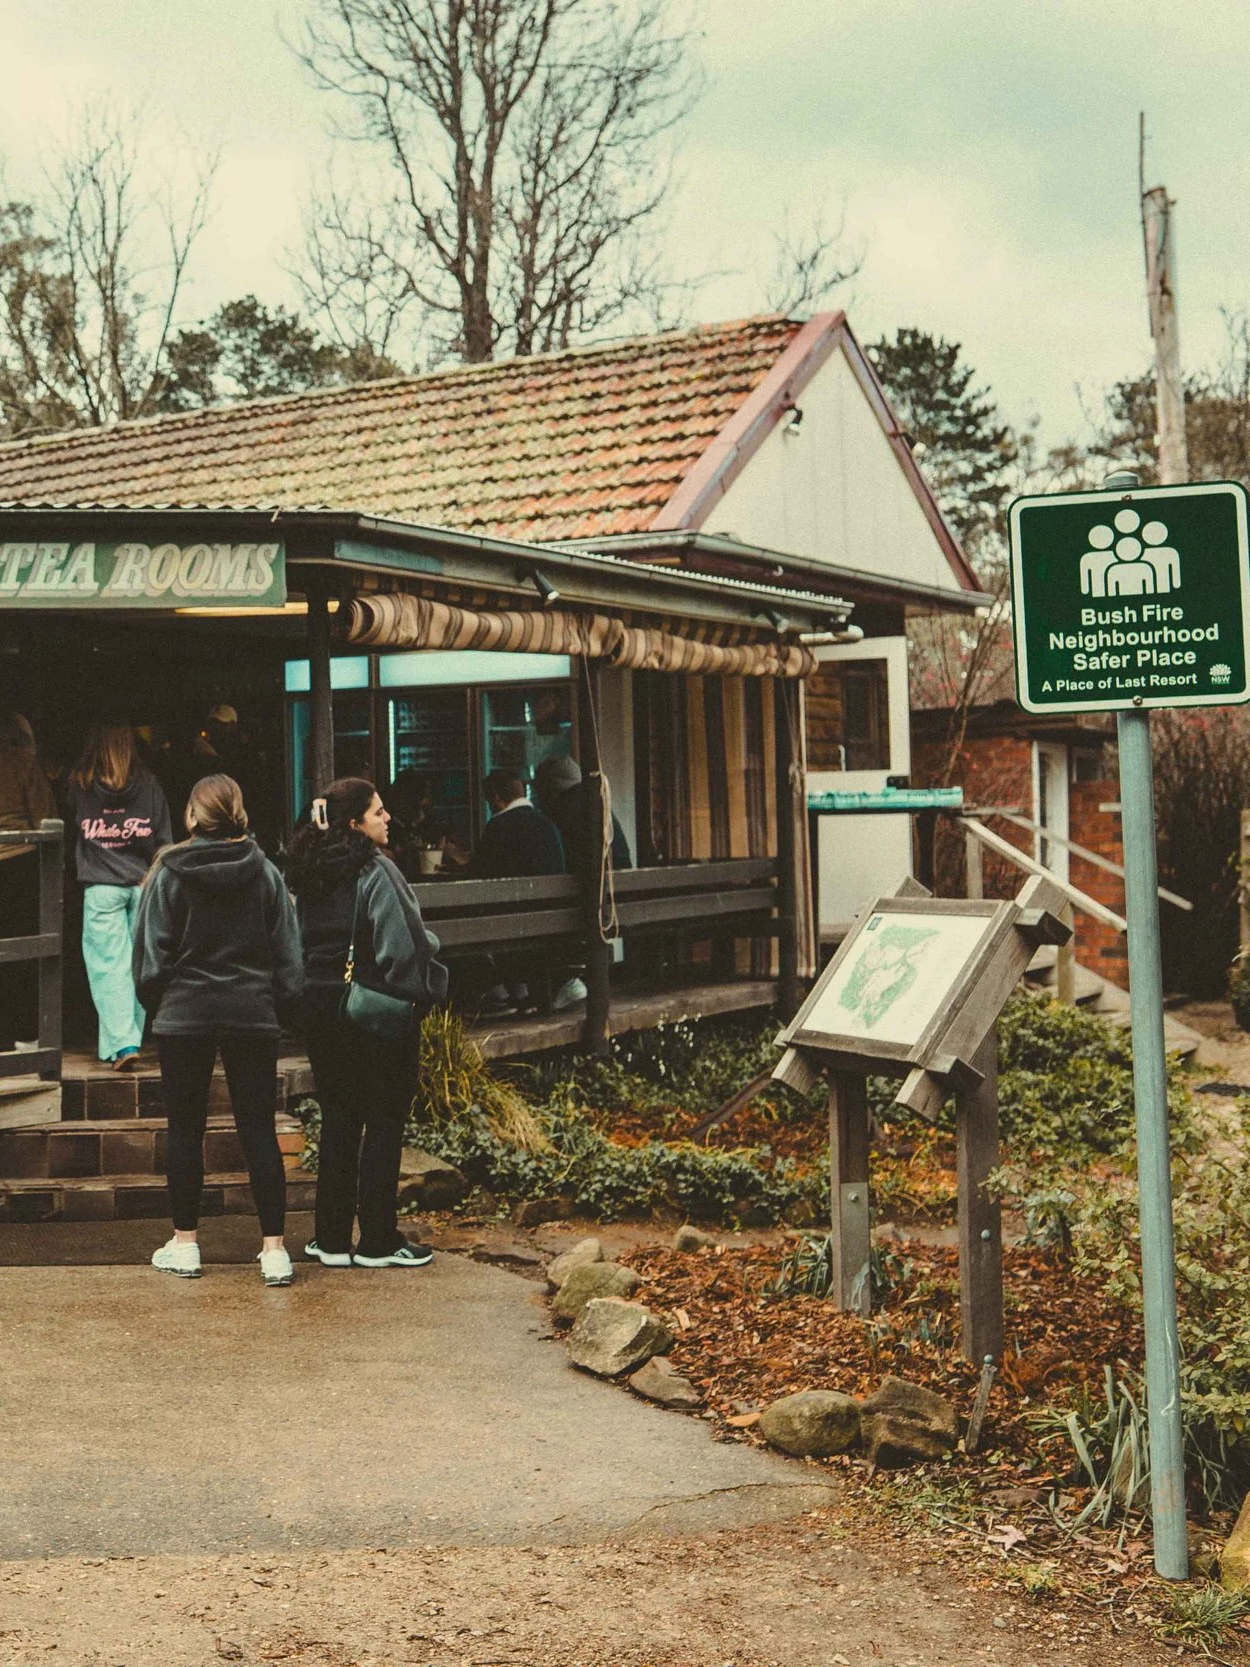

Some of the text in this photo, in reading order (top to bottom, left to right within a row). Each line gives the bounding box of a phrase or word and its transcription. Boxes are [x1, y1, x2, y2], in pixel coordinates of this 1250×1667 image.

[103, 542, 279, 597] ROOMS
[1081, 604, 1184, 626] Bush Fire
[1049, 623, 1219, 652] Neighbourhood
[1073, 649, 1197, 671] Safer Place
[1041, 673, 1198, 692] A Place of Last Resort
[1211, 676, 1230, 684] NSW
